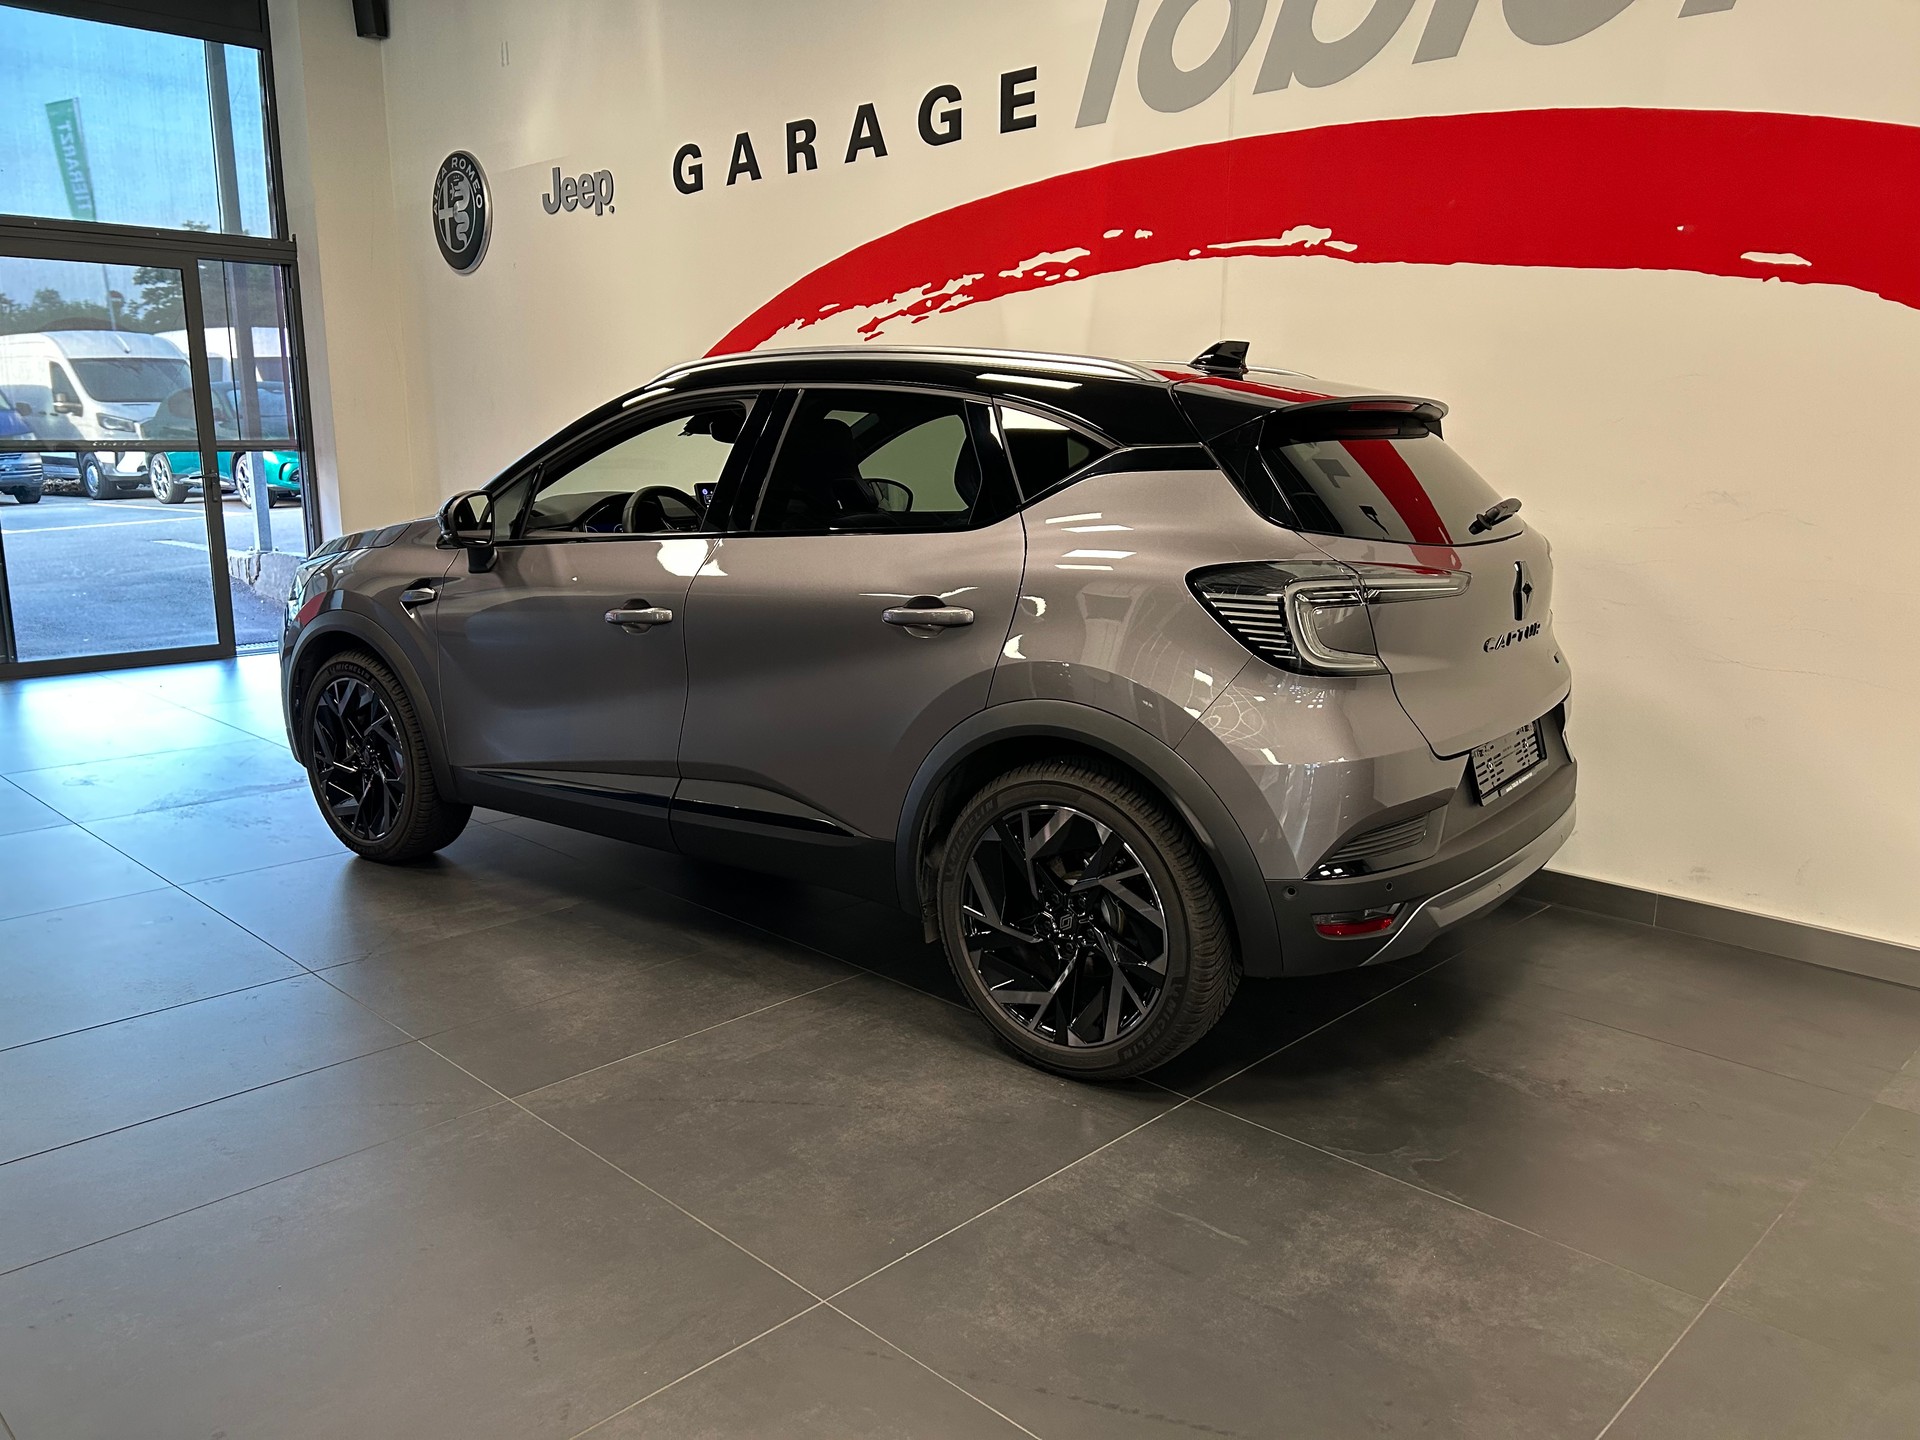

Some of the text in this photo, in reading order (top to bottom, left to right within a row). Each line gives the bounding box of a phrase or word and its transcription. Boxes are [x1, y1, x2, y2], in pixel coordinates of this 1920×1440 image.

[672, 66, 1038, 194] GARAGE
[433, 157, 483, 216] ALFA ROMEO
[542, 167, 614, 216] Jeep
[335, 663, 371, 680] MICHELIN
[949, 799, 995, 862] MICHELIN
[1122, 998, 1177, 1060] MICHELIN
